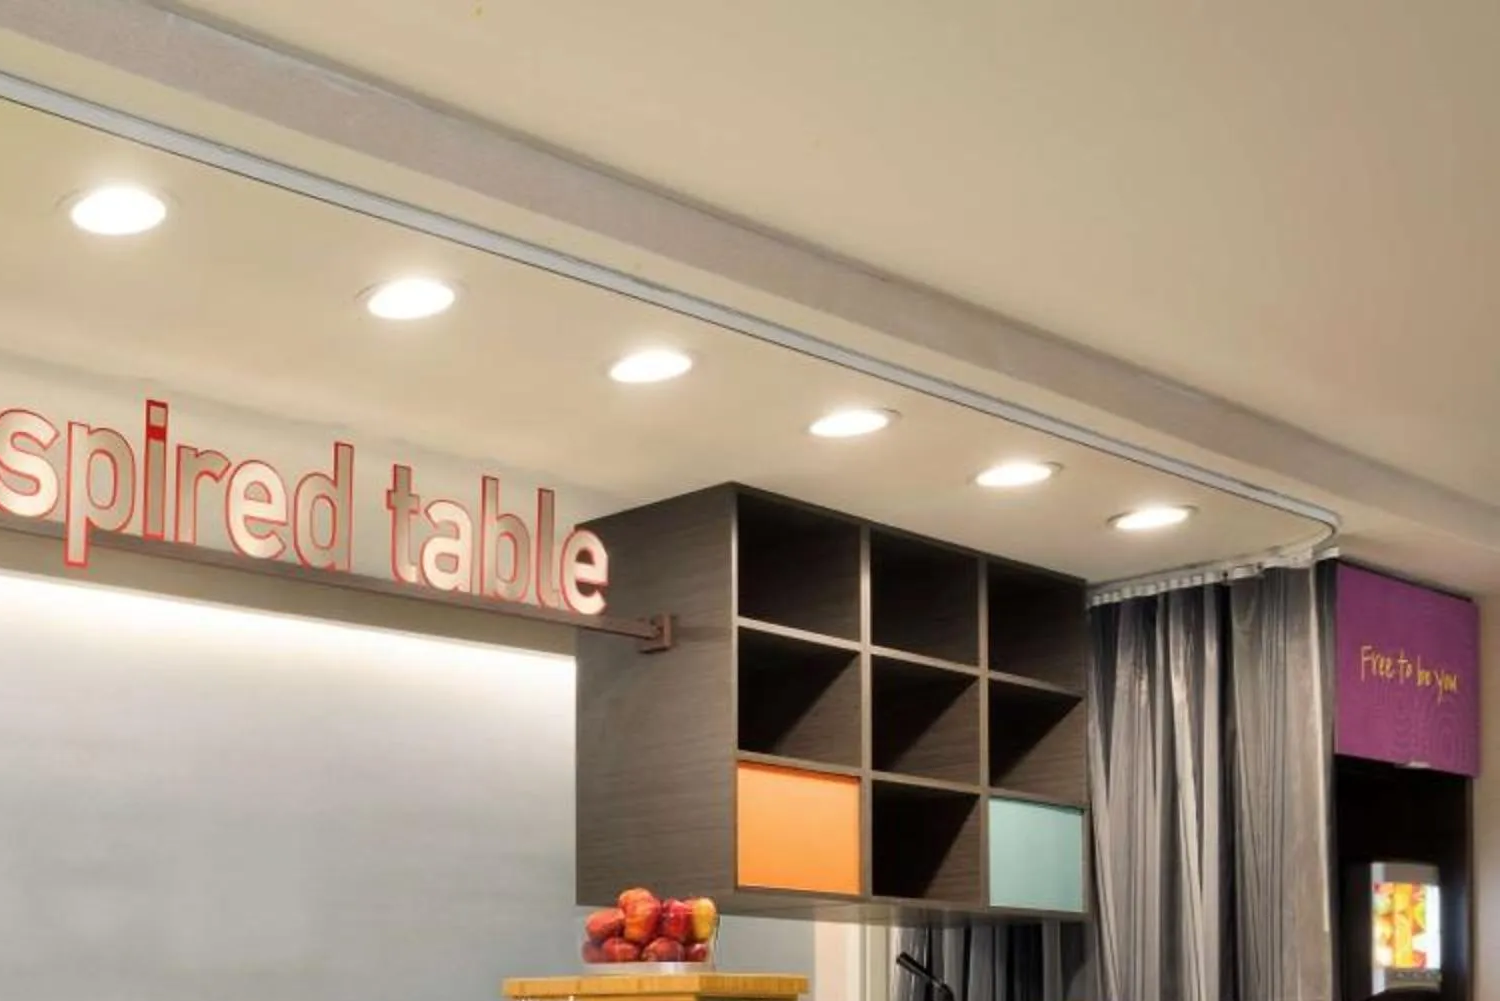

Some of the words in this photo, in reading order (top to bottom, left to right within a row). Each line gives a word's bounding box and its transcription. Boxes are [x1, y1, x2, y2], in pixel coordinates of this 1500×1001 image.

[386, 463, 609, 615] table
[1361, 645, 1394, 682] Free
[1397, 647, 1413, 684] to
[1417, 653, 1432, 687] be
[1433, 669, 1458, 704] you
